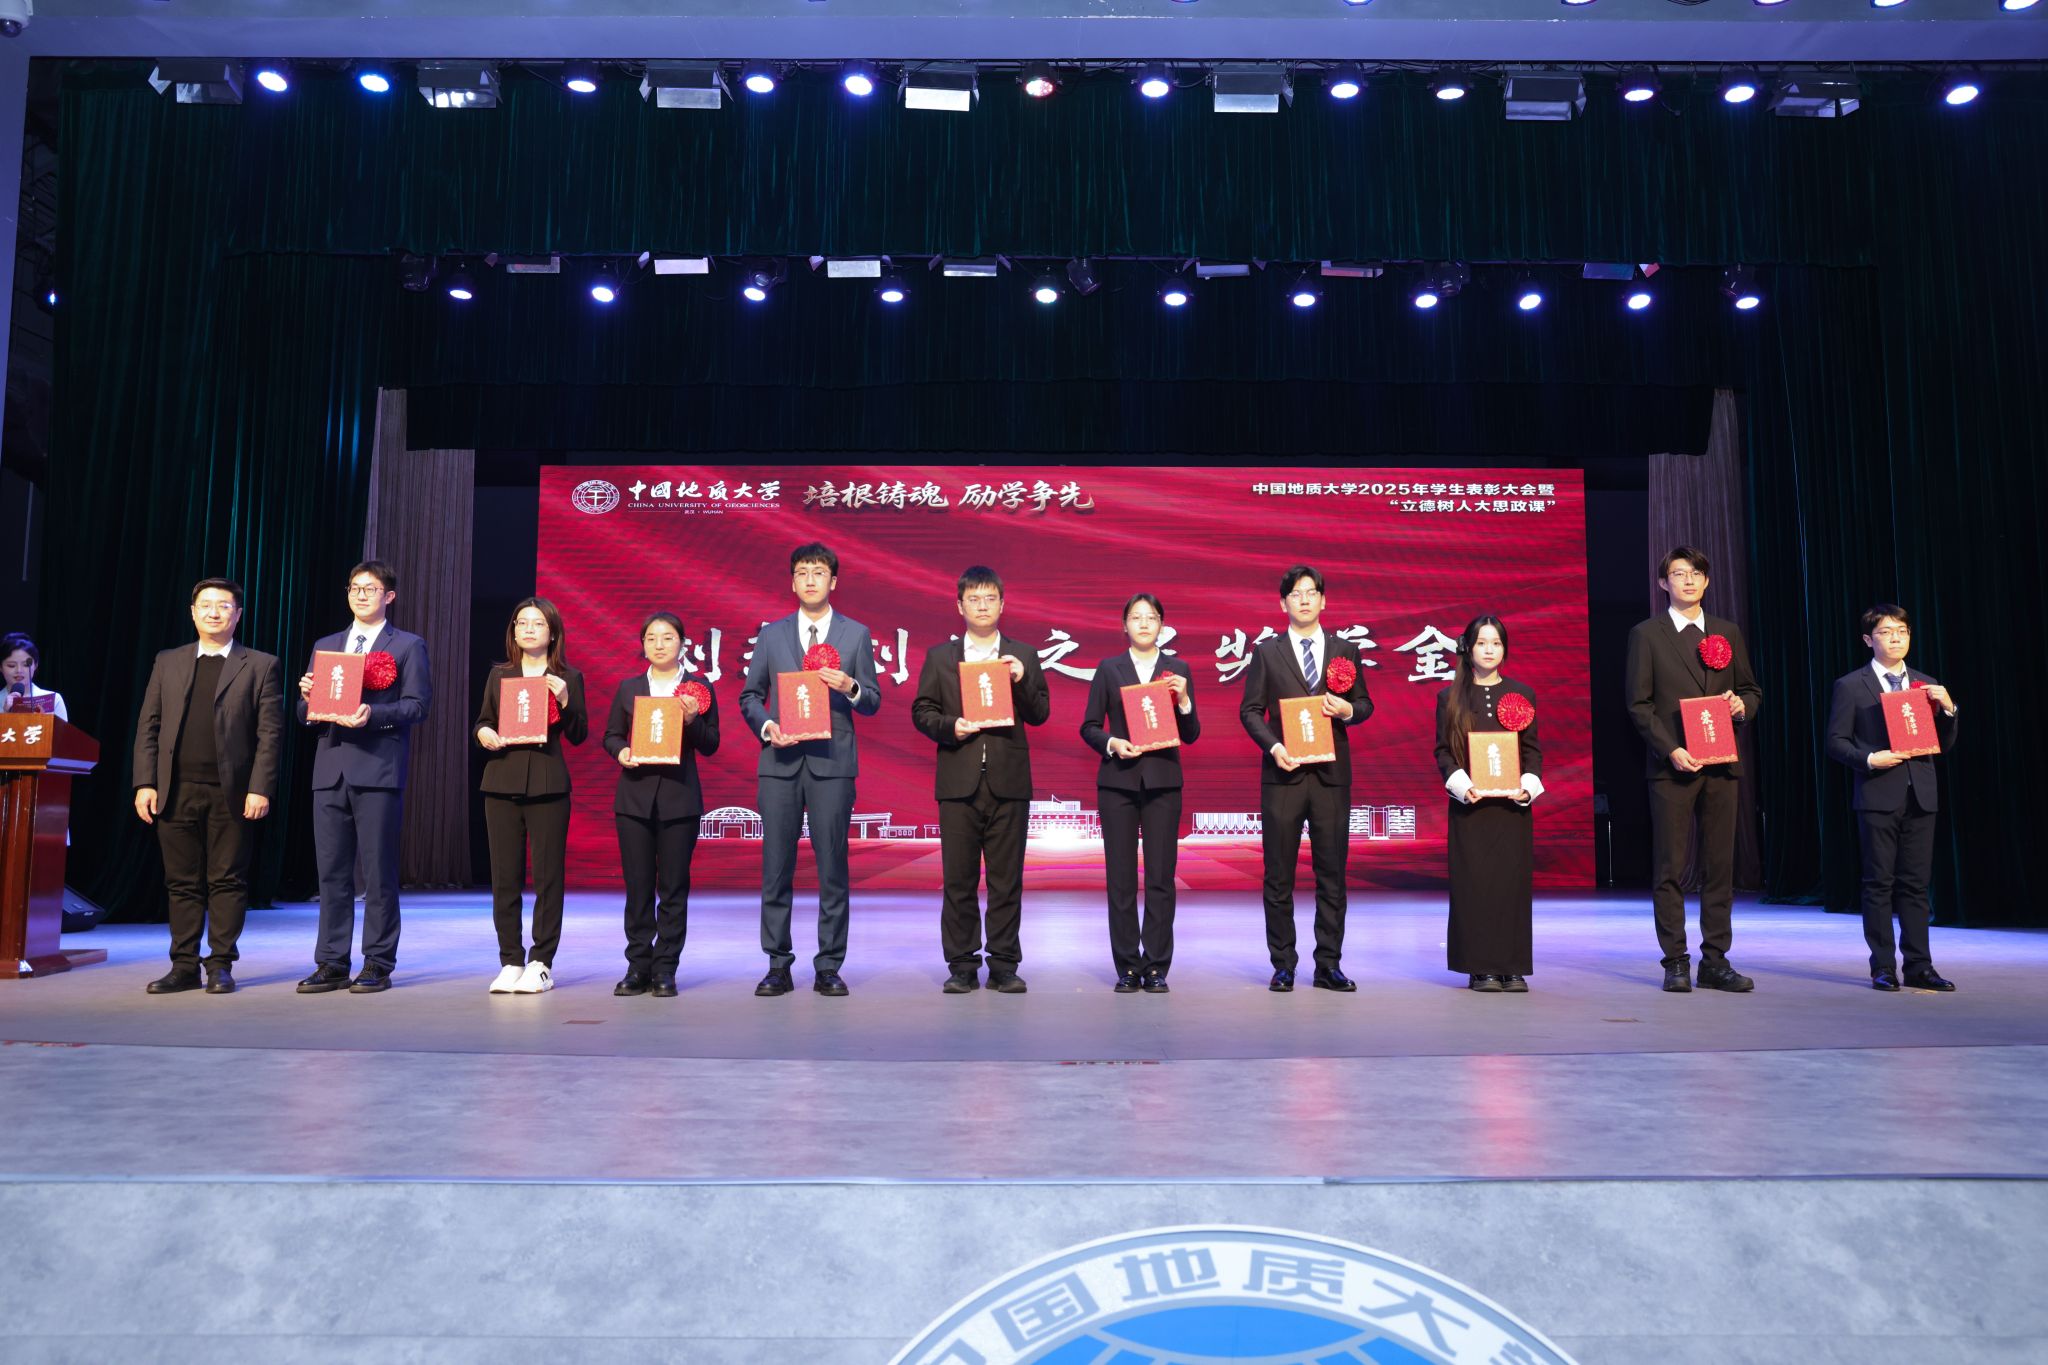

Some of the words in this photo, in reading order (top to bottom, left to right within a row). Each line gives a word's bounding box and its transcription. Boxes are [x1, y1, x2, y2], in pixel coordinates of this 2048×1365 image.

[803, 480, 950, 510] 培根铸魂
[957, 479, 1096, 512] 励学争先
[1252, 482, 1555, 496] 中国地质大学2025年学生表彰大会暨
[1389, 499, 1556, 513] “立德树人大思政课”
[1, 725, 43, 745] 大学
